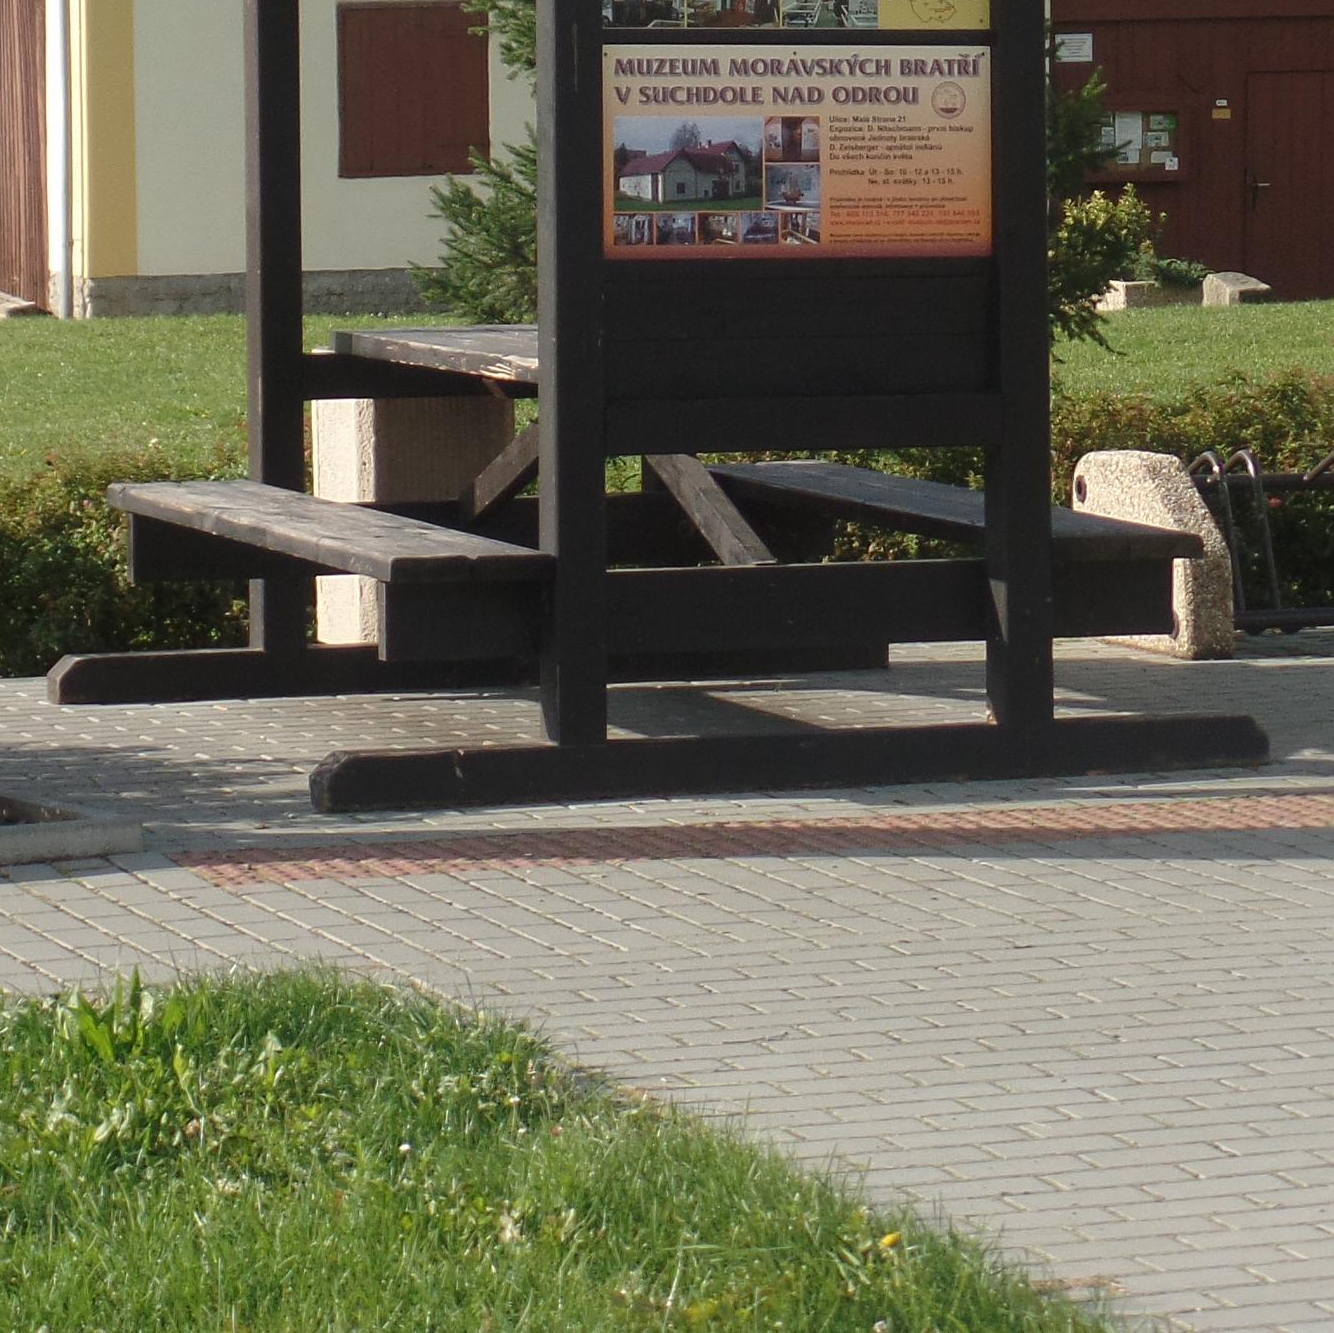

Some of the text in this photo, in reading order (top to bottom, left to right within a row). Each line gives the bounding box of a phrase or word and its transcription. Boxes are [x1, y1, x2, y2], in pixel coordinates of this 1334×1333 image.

[614, 53, 982, 77] MUZEUM MORAVSKÝCH BRATŘÍ
[616, 85, 920, 106] V SUCHDOLE NAD ODROU
